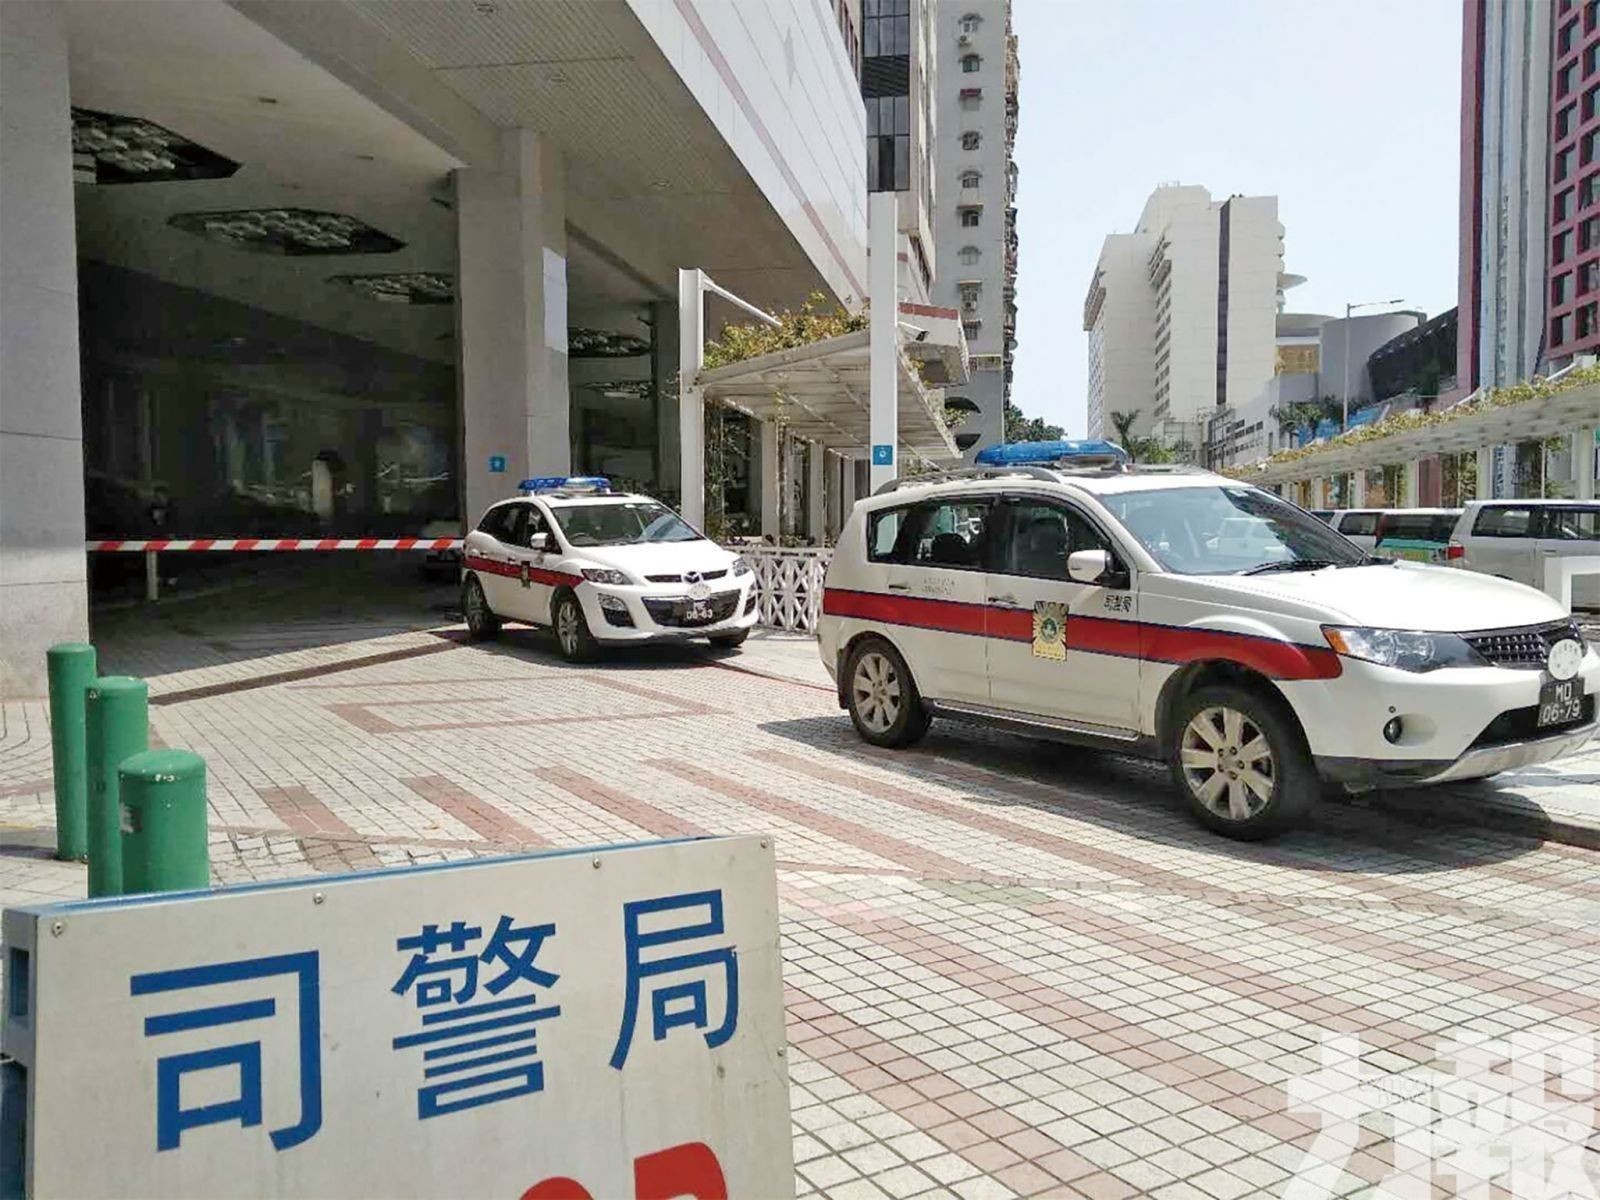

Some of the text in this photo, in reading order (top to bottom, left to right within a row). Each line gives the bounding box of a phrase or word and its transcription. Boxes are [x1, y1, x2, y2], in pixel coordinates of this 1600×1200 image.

[1542, 698, 1581, 723] 06-79
[131, 888, 738, 1152] 司警局
